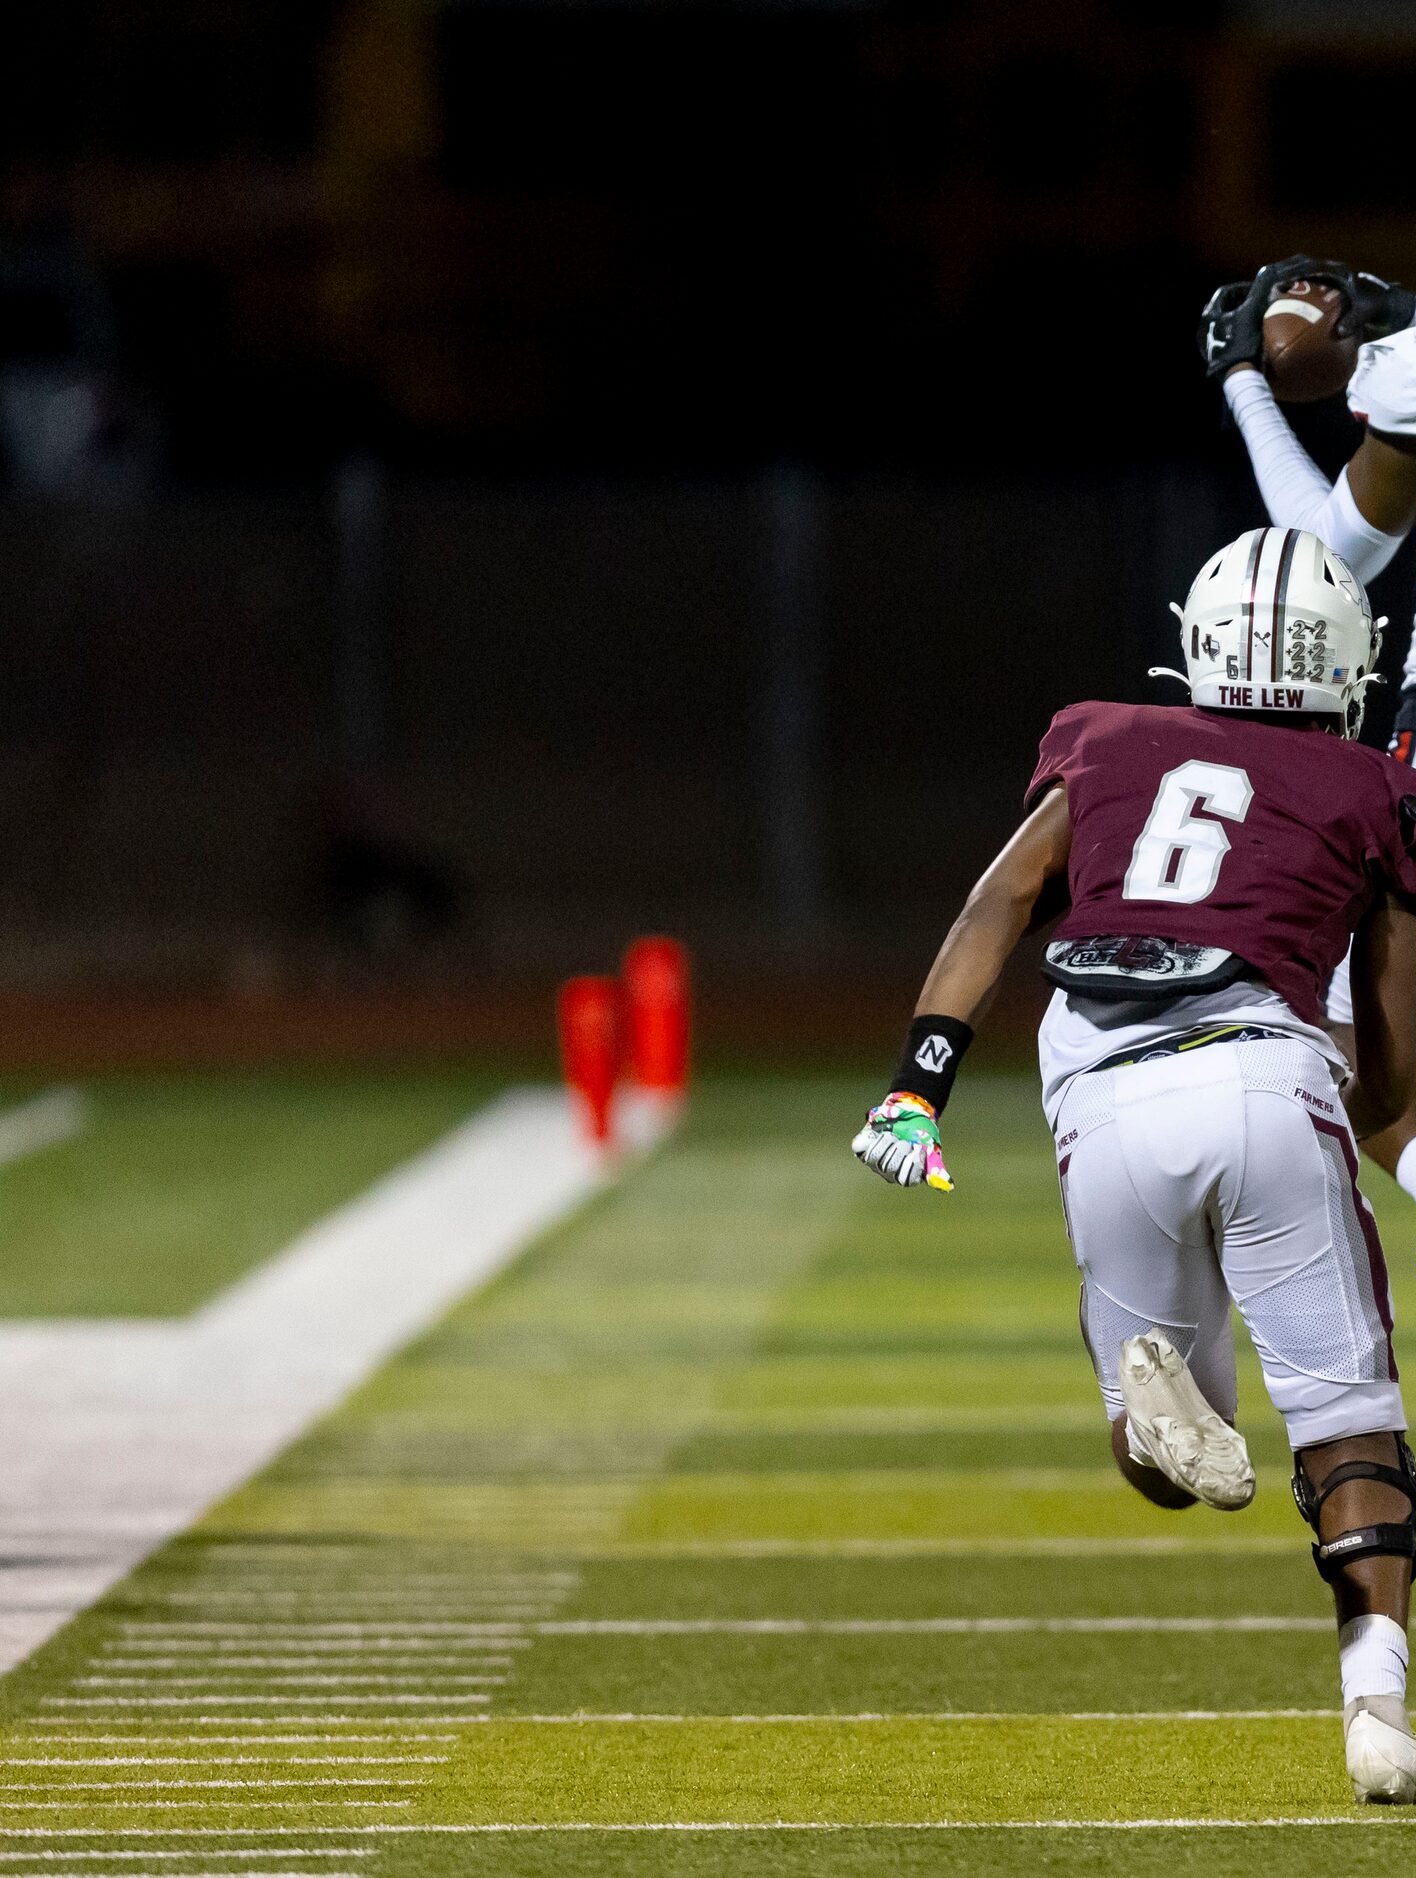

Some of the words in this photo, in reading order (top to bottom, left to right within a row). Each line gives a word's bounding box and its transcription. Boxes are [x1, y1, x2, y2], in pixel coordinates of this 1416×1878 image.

[1218, 685, 1253, 706] THE
[1261, 688, 1304, 708] LEW
[1122, 758, 1255, 904] 6
[1294, 1087, 1334, 1114] FARMERS
[1327, 1535, 1363, 1553] BREG
